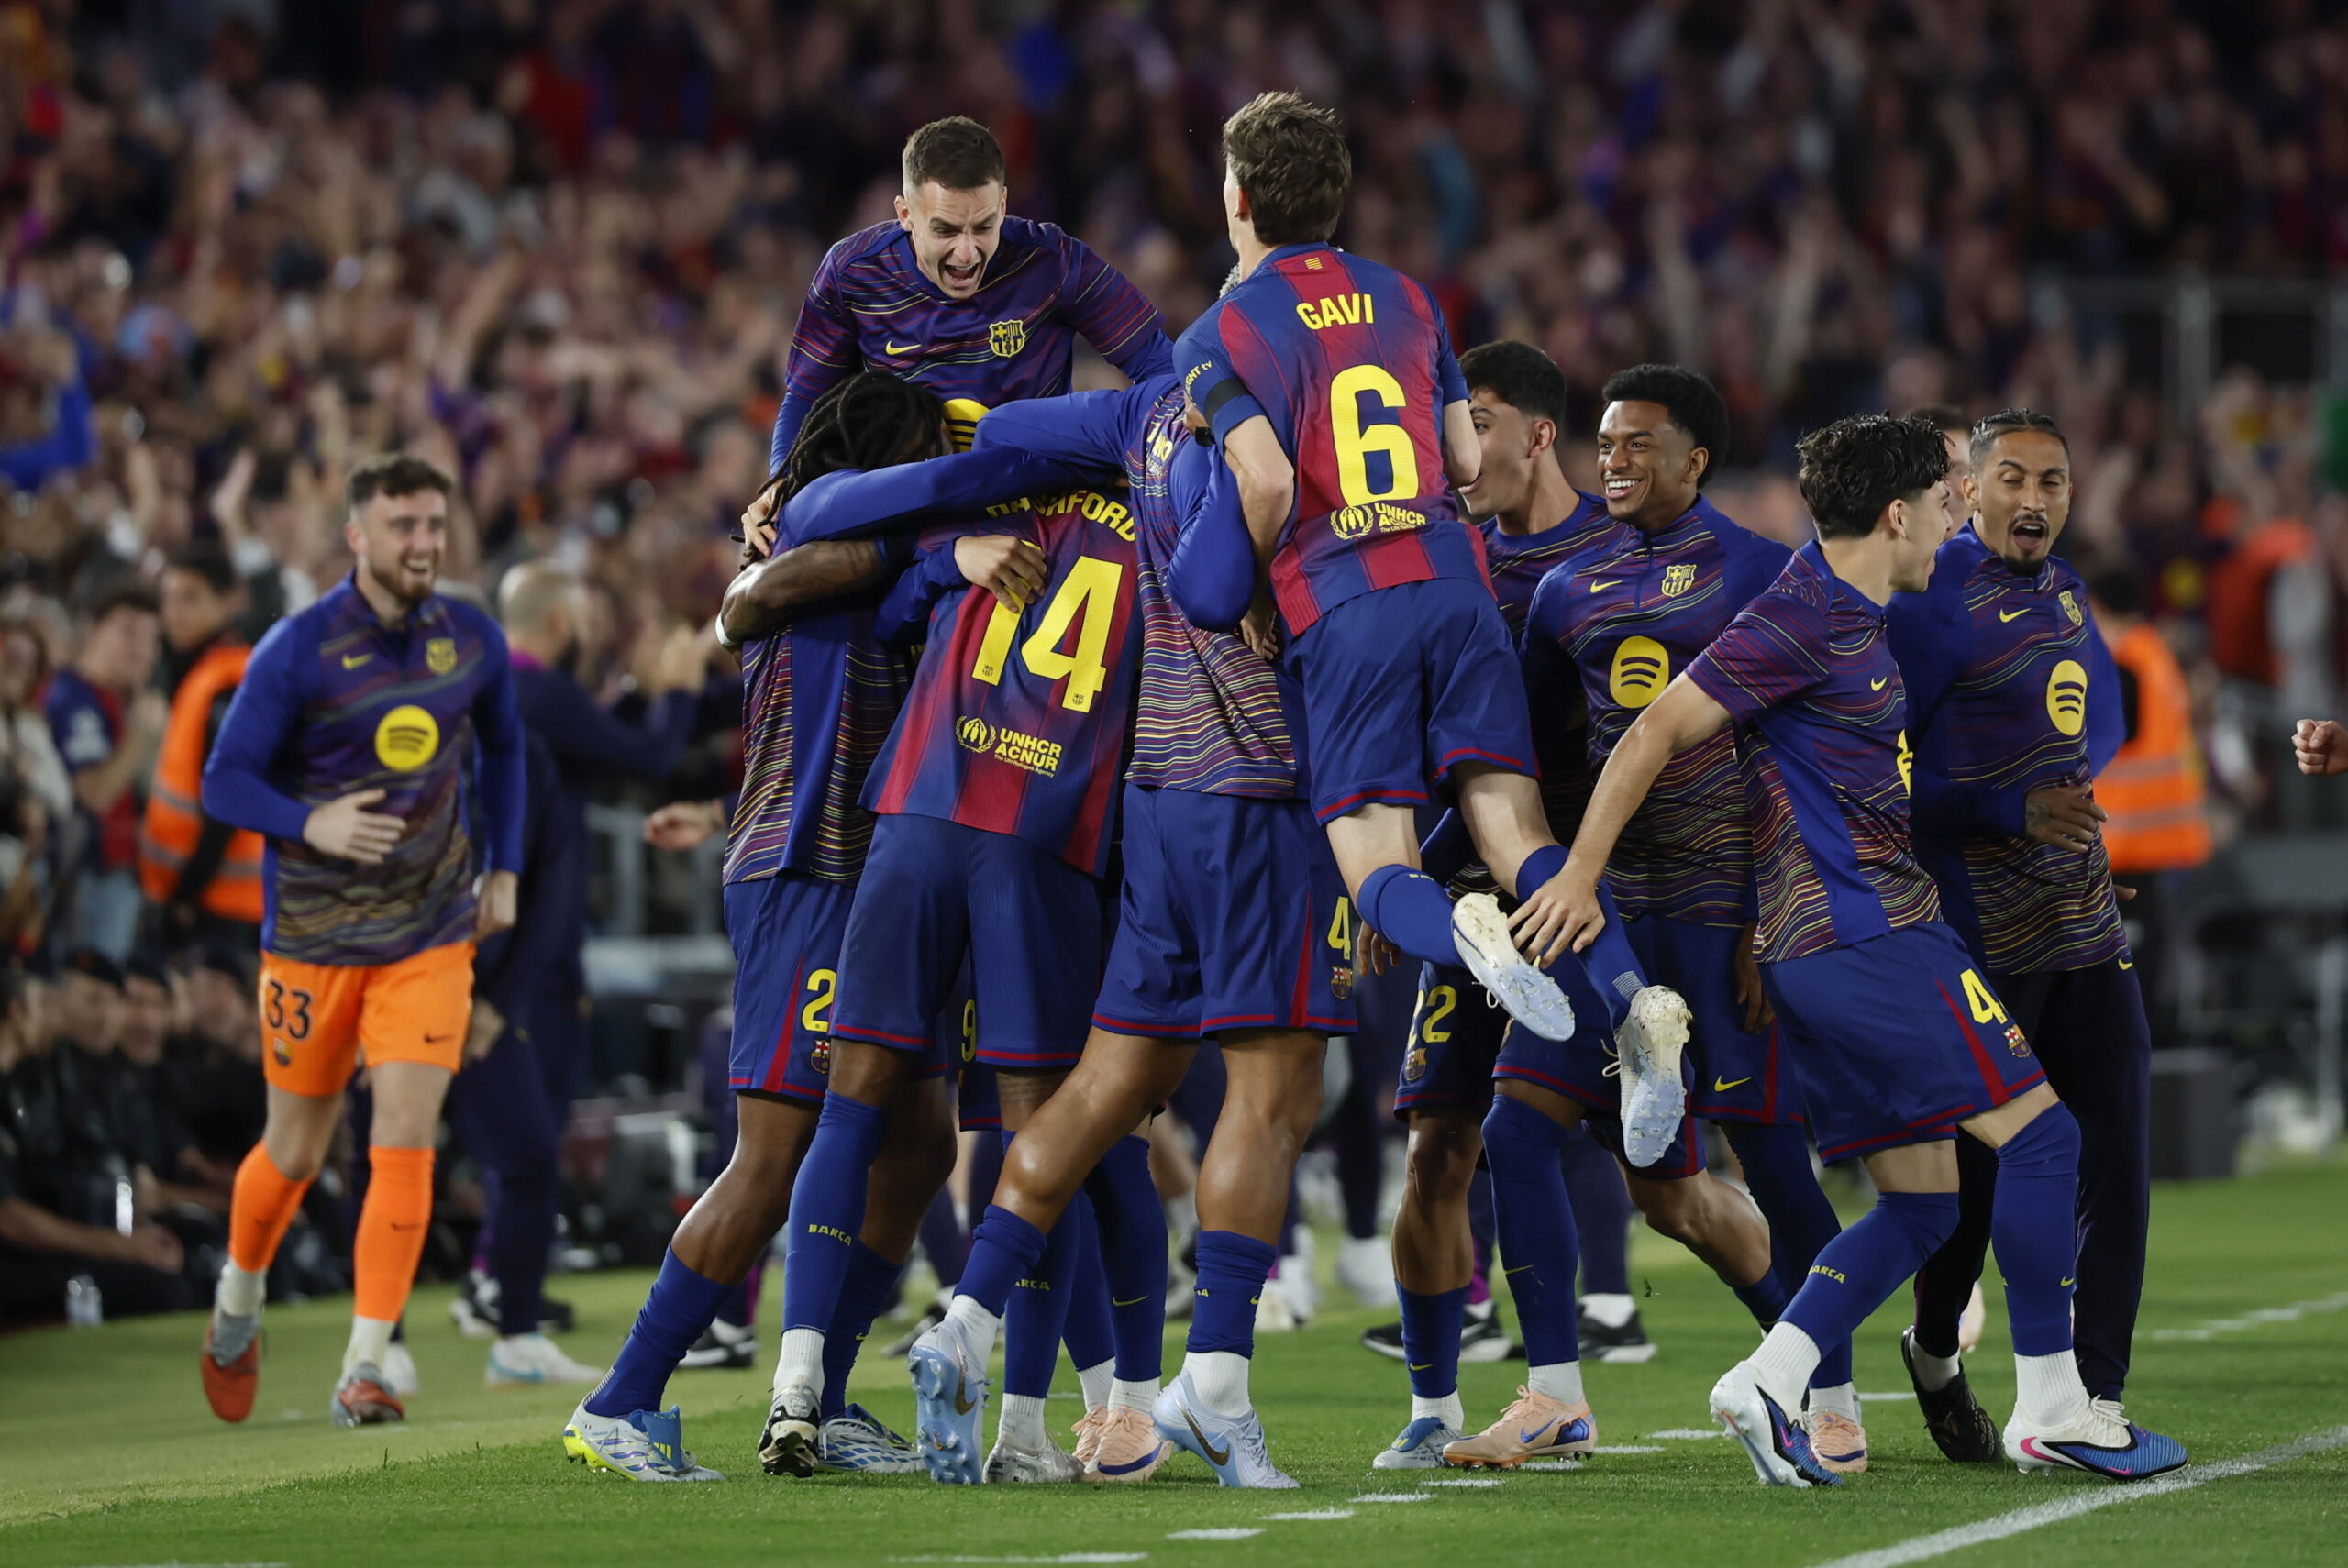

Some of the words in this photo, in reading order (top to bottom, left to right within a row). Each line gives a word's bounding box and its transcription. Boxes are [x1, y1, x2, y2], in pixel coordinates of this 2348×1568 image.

[1296, 293, 1374, 330] GAVI
[1331, 364, 1419, 507] 6
[1374, 502, 1426, 525] UNHCR
[971, 540, 1123, 713] 14
[995, 743, 1058, 772] ACNUR
[1000, 727, 1062, 758] UNHCR
[1327, 896, 1351, 960] 4
[267, 978, 312, 1040] 33
